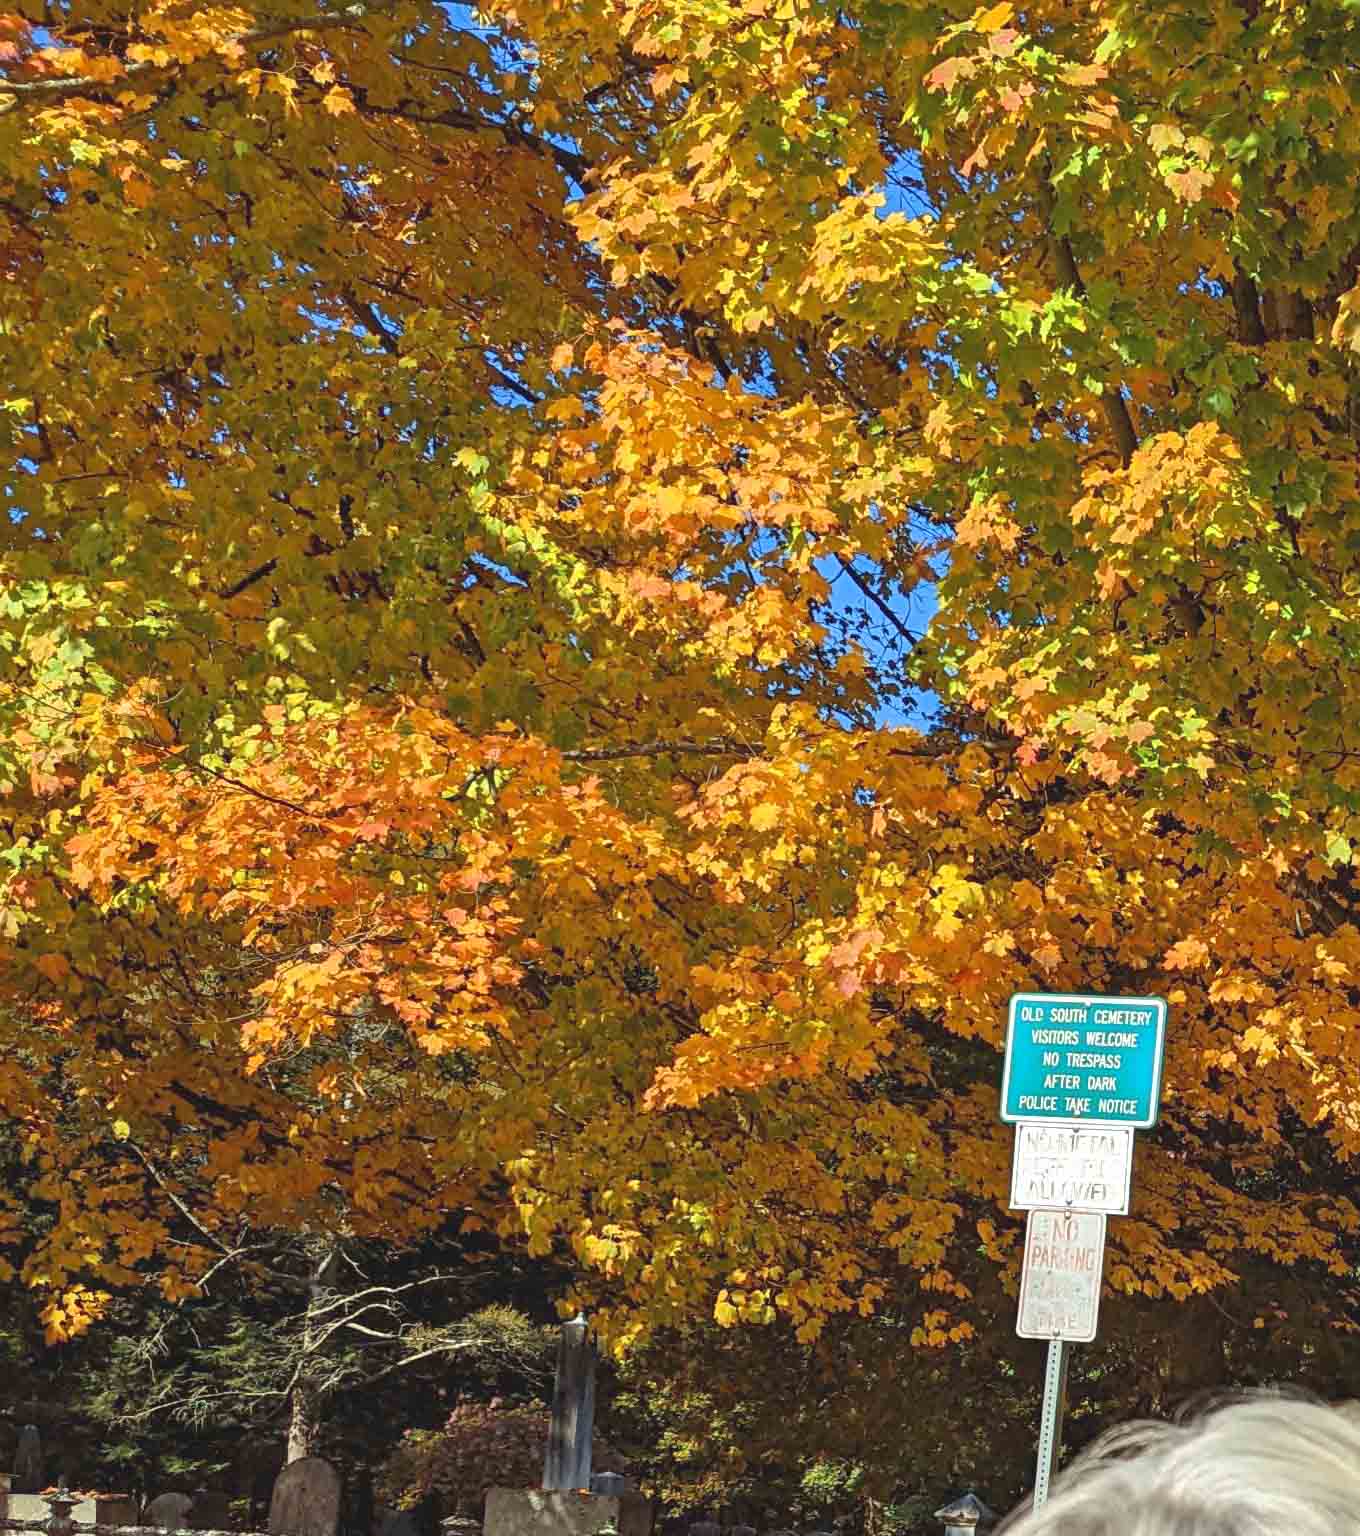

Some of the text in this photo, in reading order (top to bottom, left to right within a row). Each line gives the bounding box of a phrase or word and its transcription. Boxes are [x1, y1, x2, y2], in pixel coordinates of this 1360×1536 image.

[1021, 1007, 1152, 1026] OLD SOUTH CEMETERY
[1032, 1029, 1138, 1048] VISITORS WELCOME
[1043, 1051, 1121, 1069] NO TRESPASS
[1044, 1075, 1117, 1091] AFTER DARK
[1019, 1095, 1137, 1114] POLICE TAKE NOTICE
[1052, 1218, 1079, 1241] NO
[1032, 1244, 1096, 1272] PARKING
